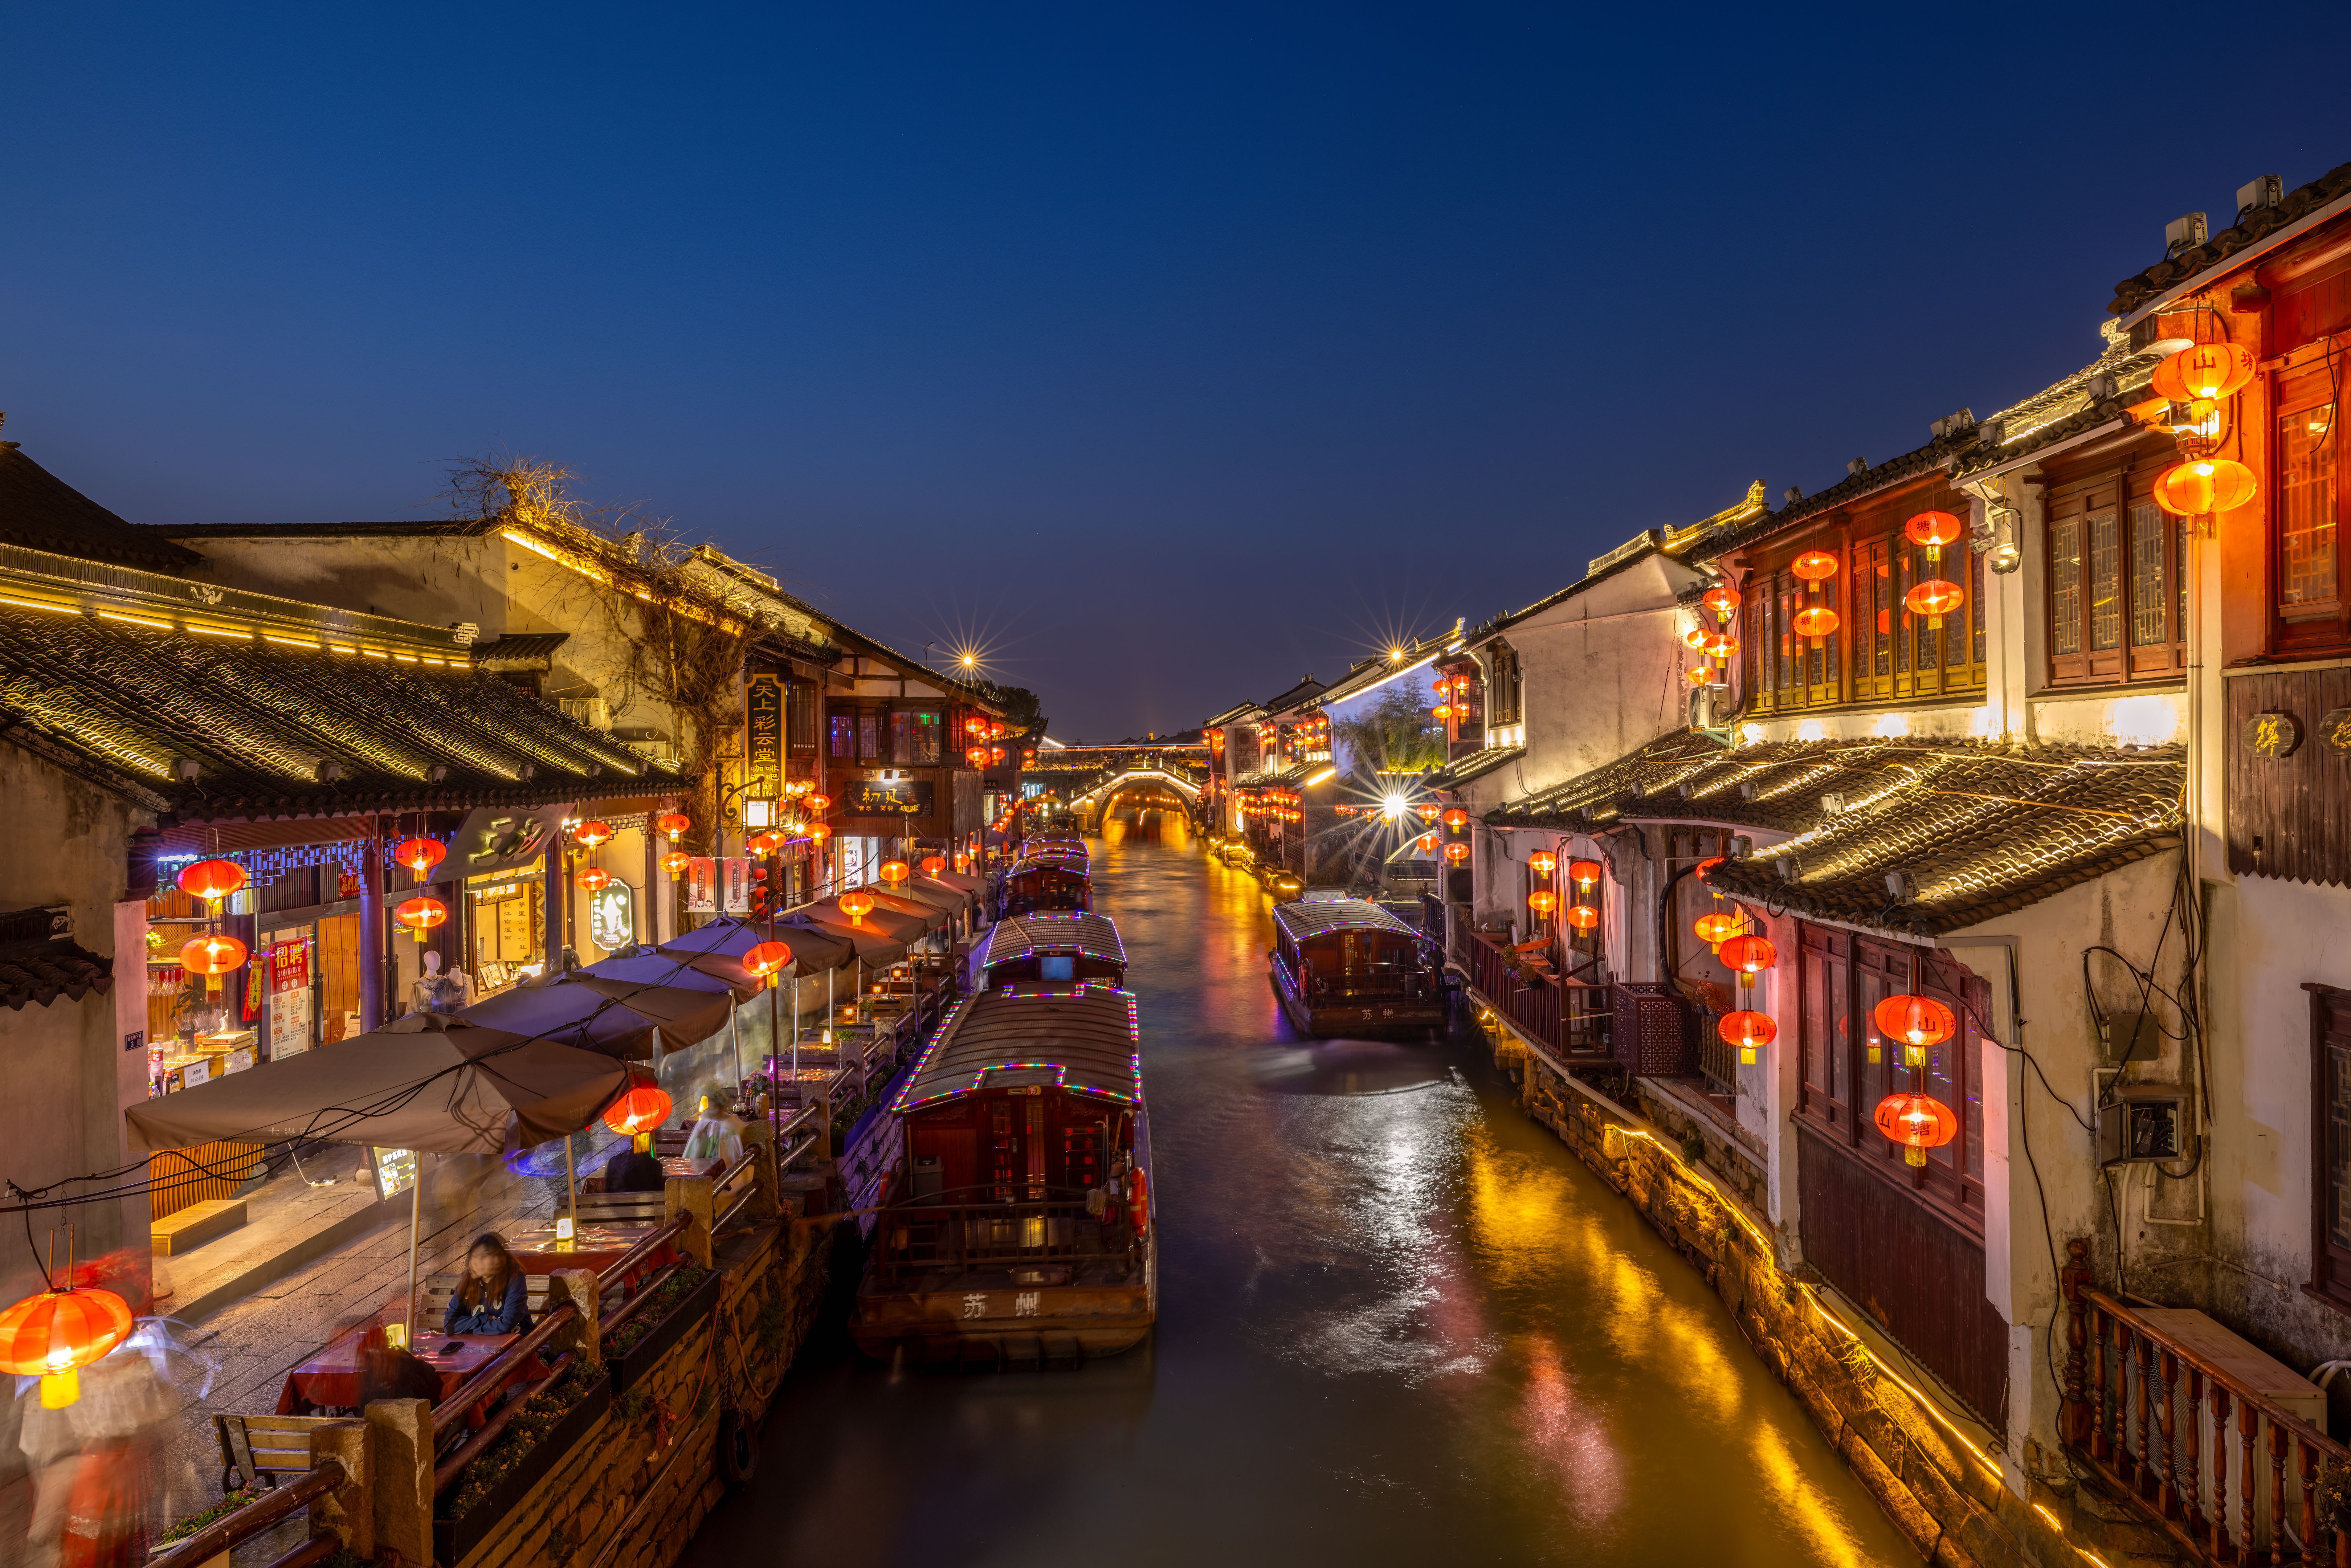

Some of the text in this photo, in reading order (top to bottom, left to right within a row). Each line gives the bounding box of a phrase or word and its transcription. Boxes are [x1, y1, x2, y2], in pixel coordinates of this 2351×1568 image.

[753, 685, 776, 763] 天上彩云堂
[750, 764, 779, 772] 咖啡
[862, 787, 903, 805] 初见
[275, 943, 302, 968] 招聘
[1362, 1008, 1393, 1020] 苏州
[963, 1291, 1041, 1319] 苏州
